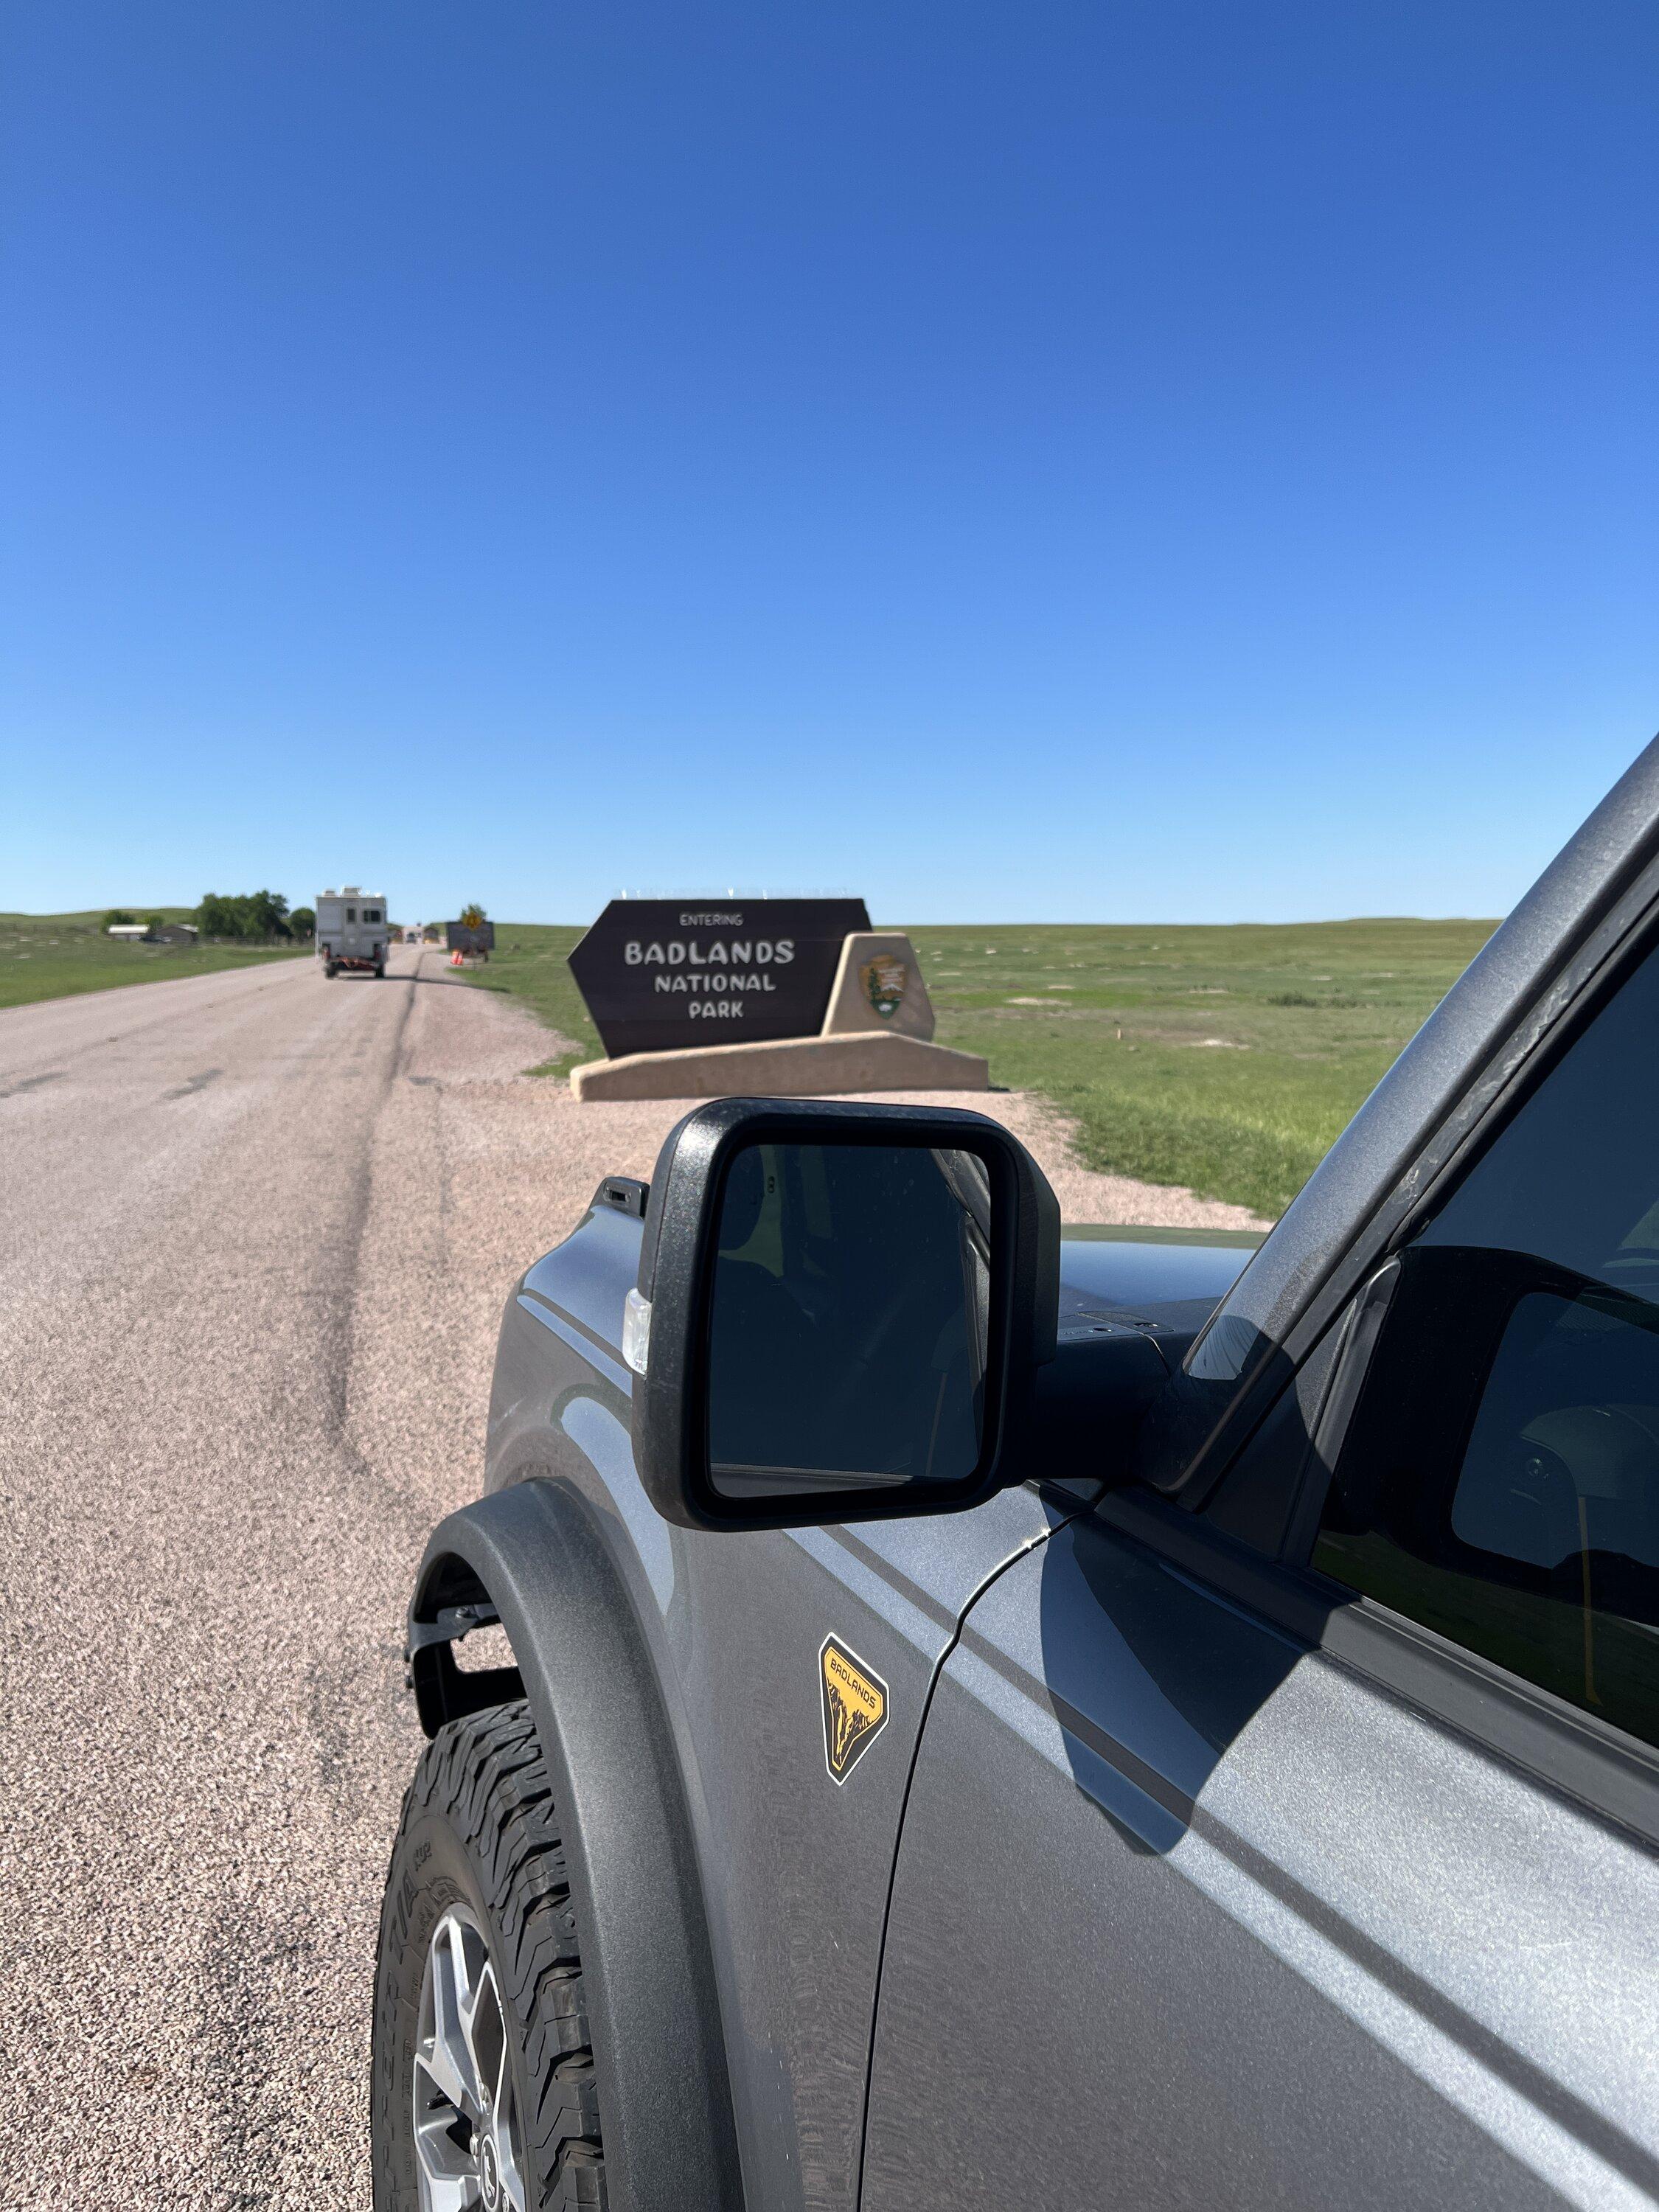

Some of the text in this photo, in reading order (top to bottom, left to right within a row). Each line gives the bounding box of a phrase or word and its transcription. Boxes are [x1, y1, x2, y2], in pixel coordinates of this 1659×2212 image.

[679, 913, 744, 927] ENTERING
[625, 939, 796, 965] BADLANDS
[654, 973, 777, 993] NATIONAL
[688, 1000, 745, 1020] PARK
[830, 1658, 877, 1709] BADLANDS
